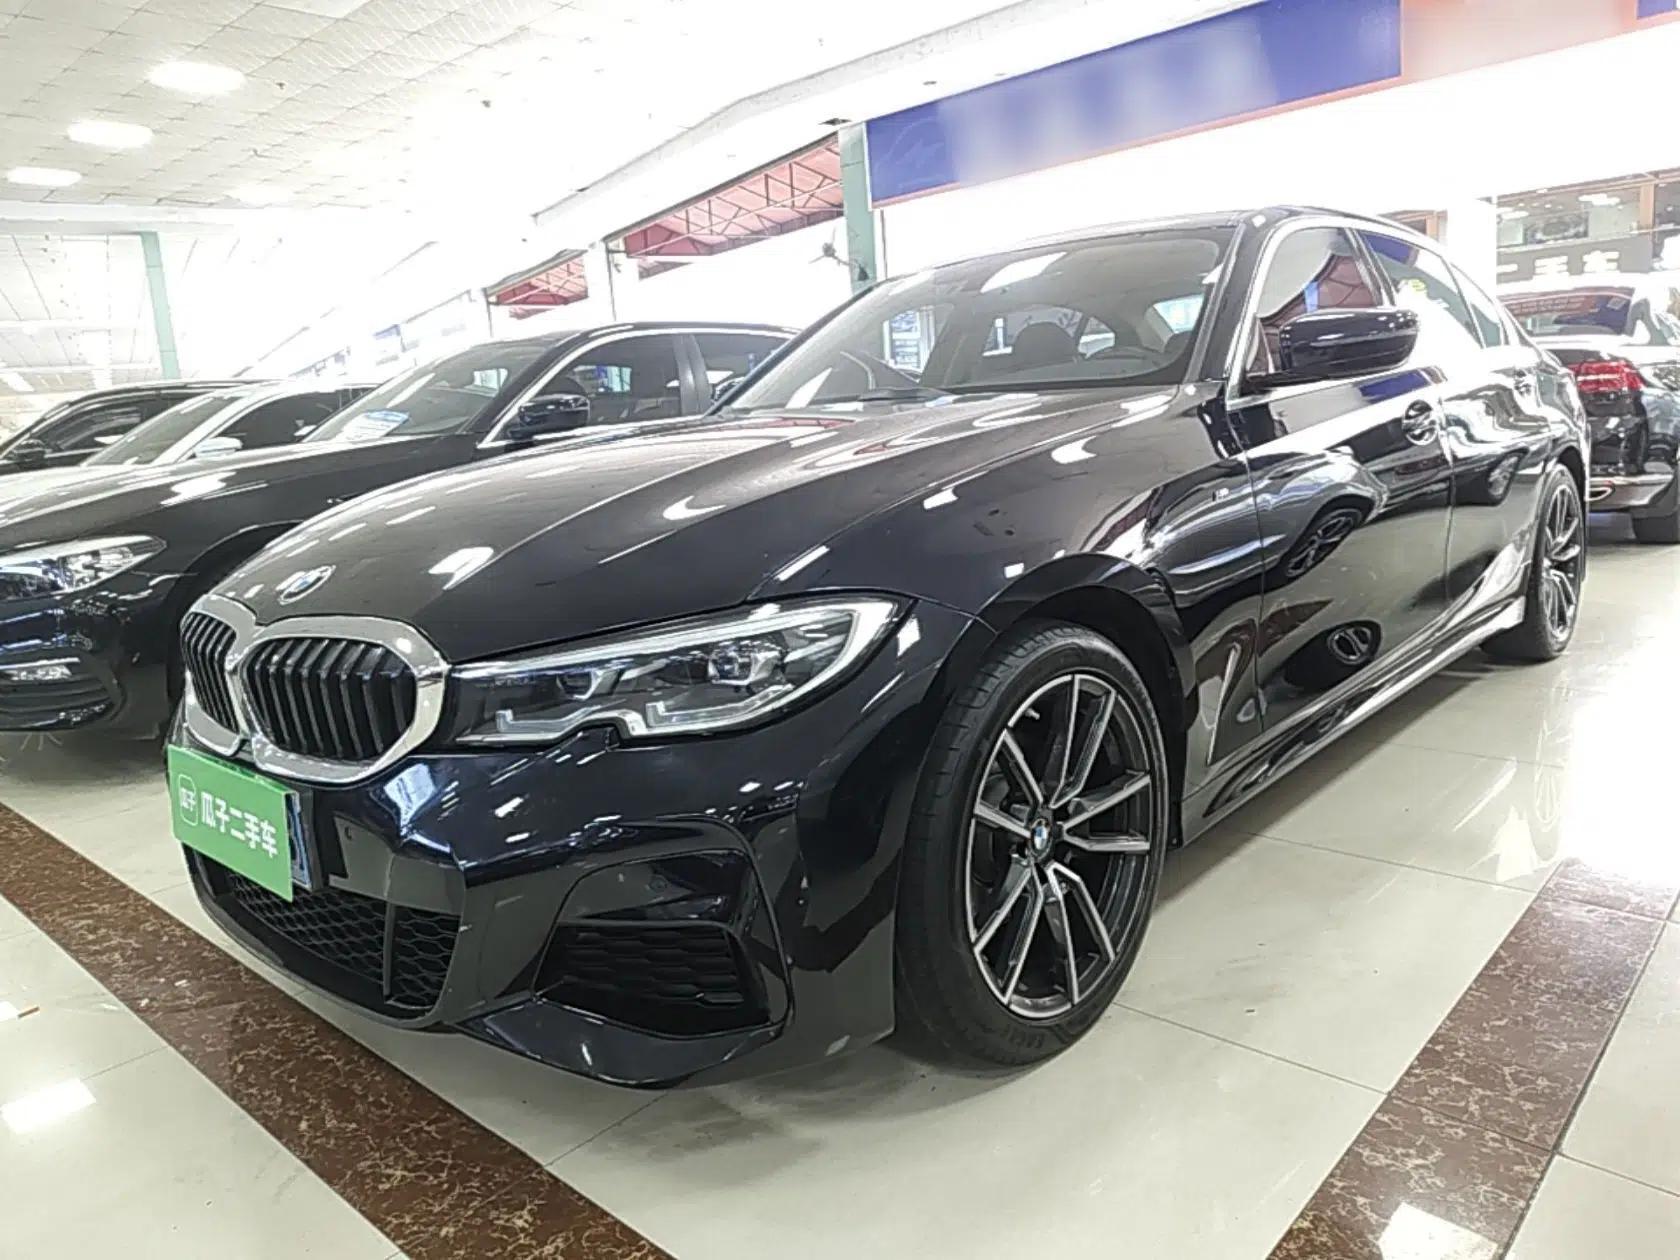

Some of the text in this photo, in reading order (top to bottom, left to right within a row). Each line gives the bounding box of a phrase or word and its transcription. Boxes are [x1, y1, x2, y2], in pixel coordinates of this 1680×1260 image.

[201, 790, 279, 859] 瓜子二手车
